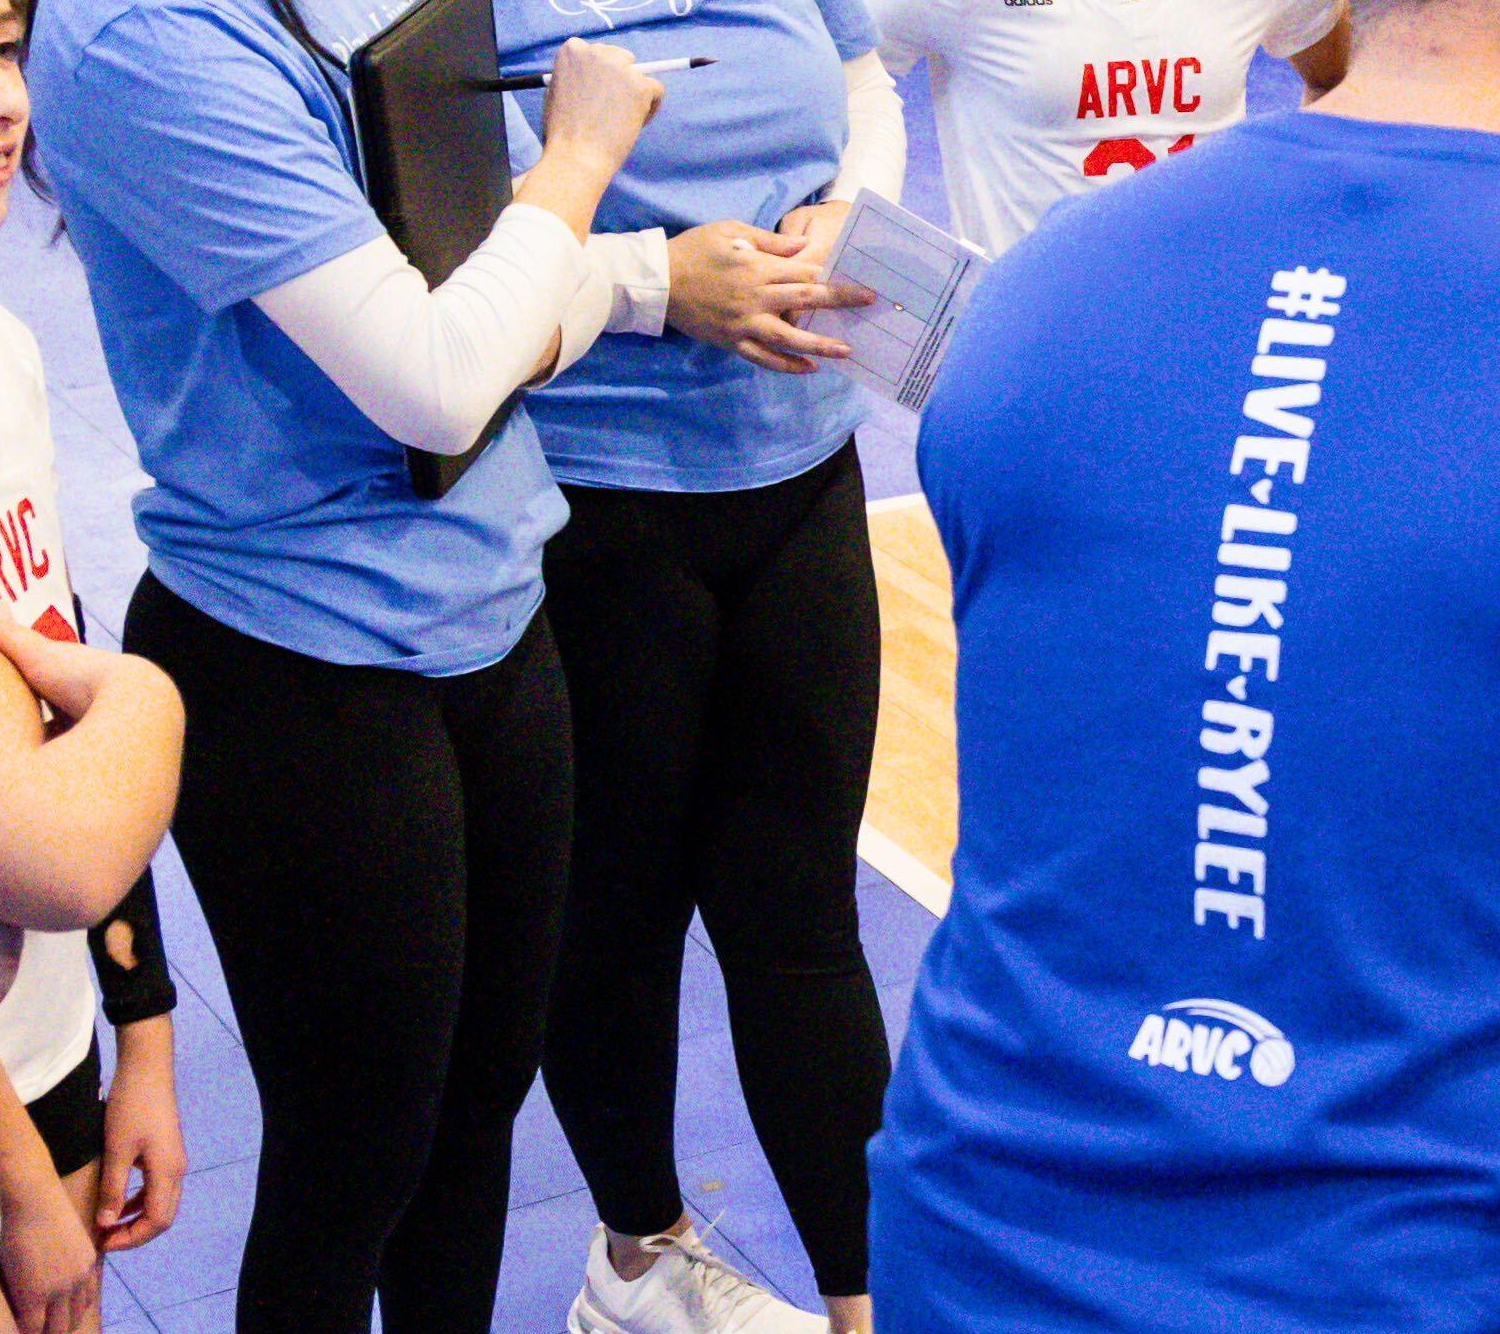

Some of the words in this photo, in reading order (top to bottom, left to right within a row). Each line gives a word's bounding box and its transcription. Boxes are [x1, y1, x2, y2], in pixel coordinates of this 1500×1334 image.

[1077, 56, 1201, 120] ARVC
[1229, 264, 1347, 486] #LIVE
[1203, 503, 1299, 682] LIKE
[1193, 699, 1274, 940] RYLEE
[1128, 1013, 1252, 1081] ARVC
